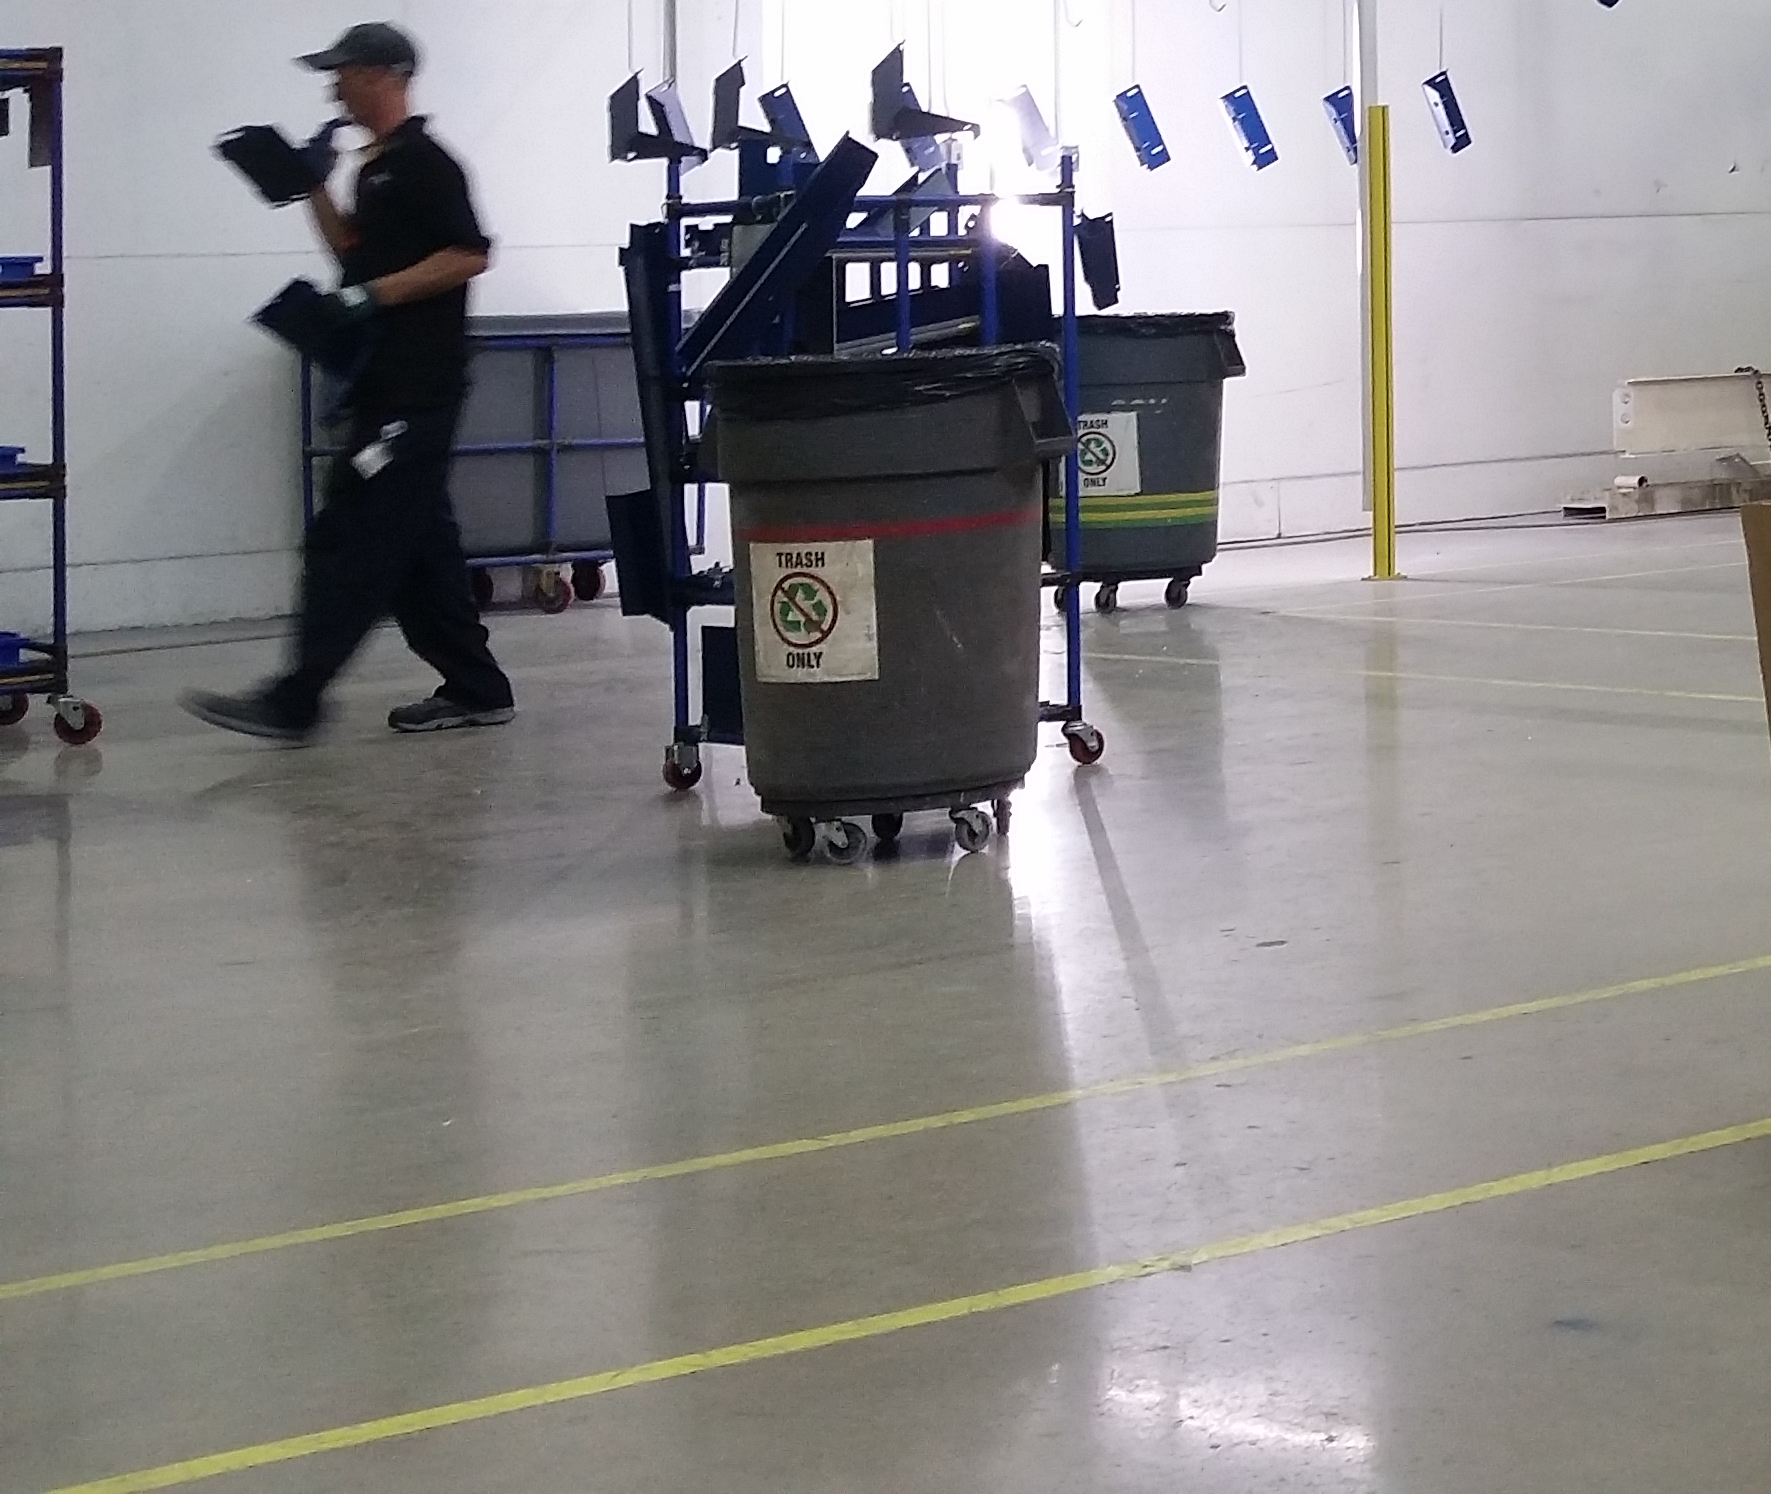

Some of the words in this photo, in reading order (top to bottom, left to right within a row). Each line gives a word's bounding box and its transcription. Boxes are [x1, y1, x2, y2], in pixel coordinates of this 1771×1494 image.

[1077, 418, 1108, 430] TRASH
[1083, 477, 1107, 488] ONLY
[776, 551, 825, 569] TRASH
[786, 651, 823, 669] ONLY
